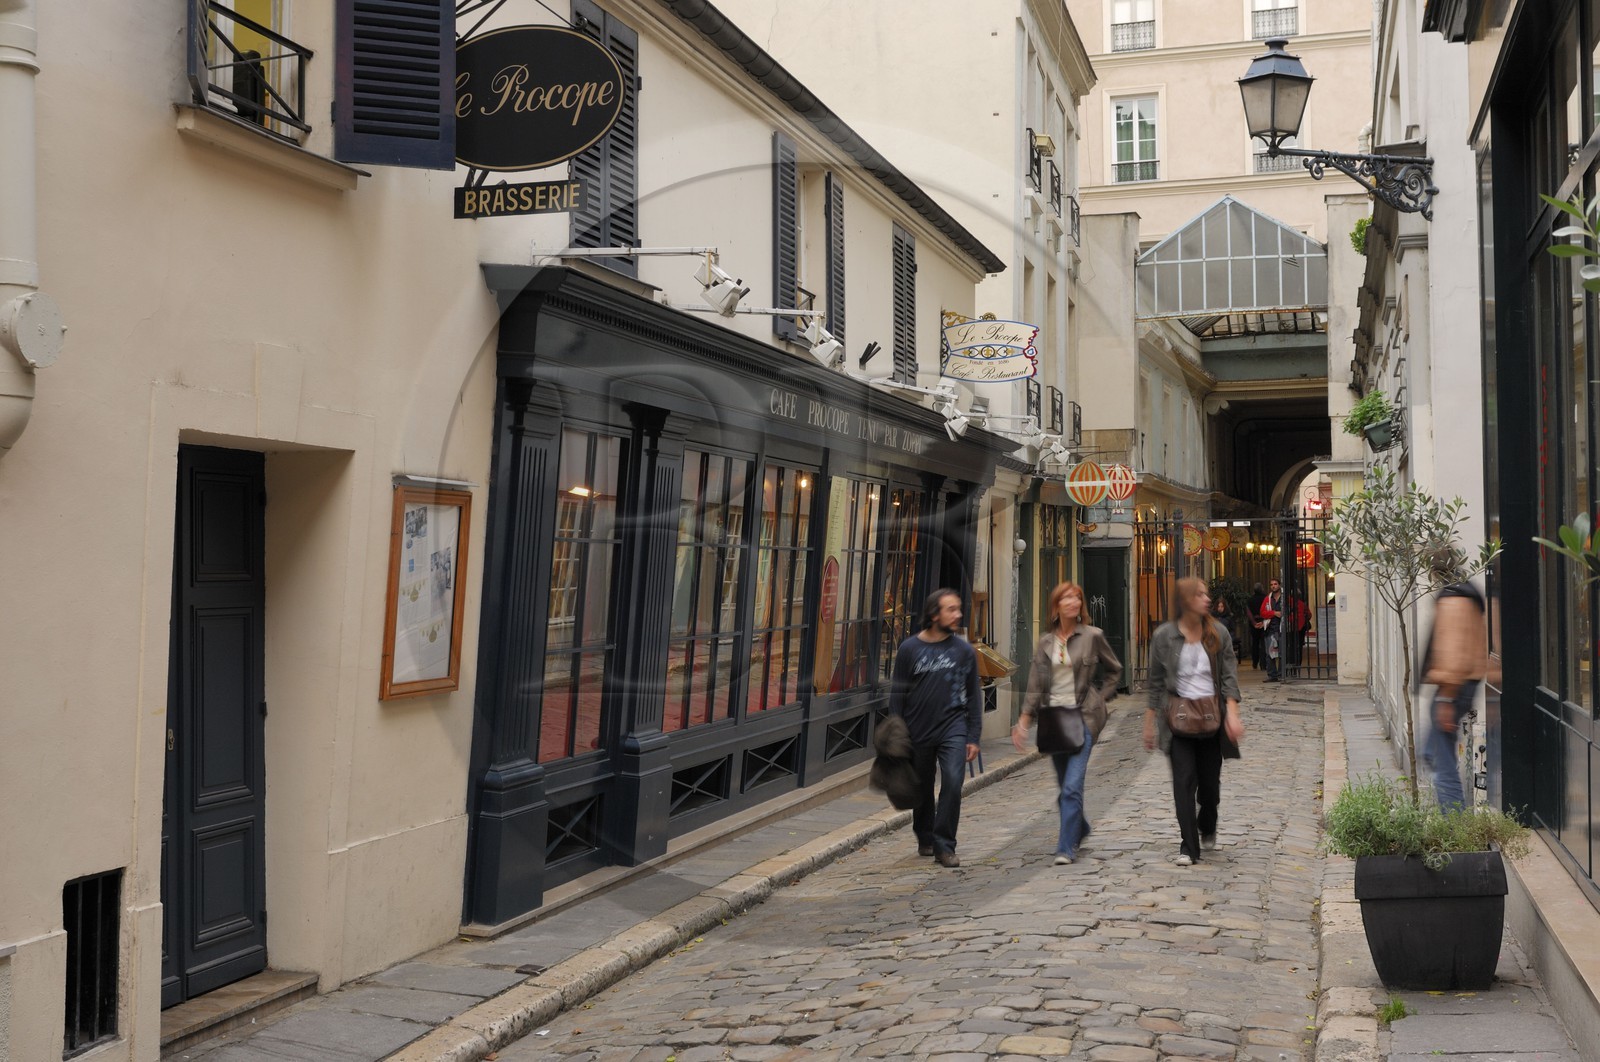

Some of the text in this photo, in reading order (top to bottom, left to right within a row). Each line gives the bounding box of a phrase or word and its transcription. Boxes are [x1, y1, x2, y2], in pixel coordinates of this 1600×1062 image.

[481, 64, 614, 126] Procope
[464, 183, 581, 216] BRASSERIE
[954, 323, 1024, 345] Le Procope
[978, 366, 1029, 380] Restaurant
[770, 388, 922, 455] CAFE PROCOPE TENU PAR ZOPPI
